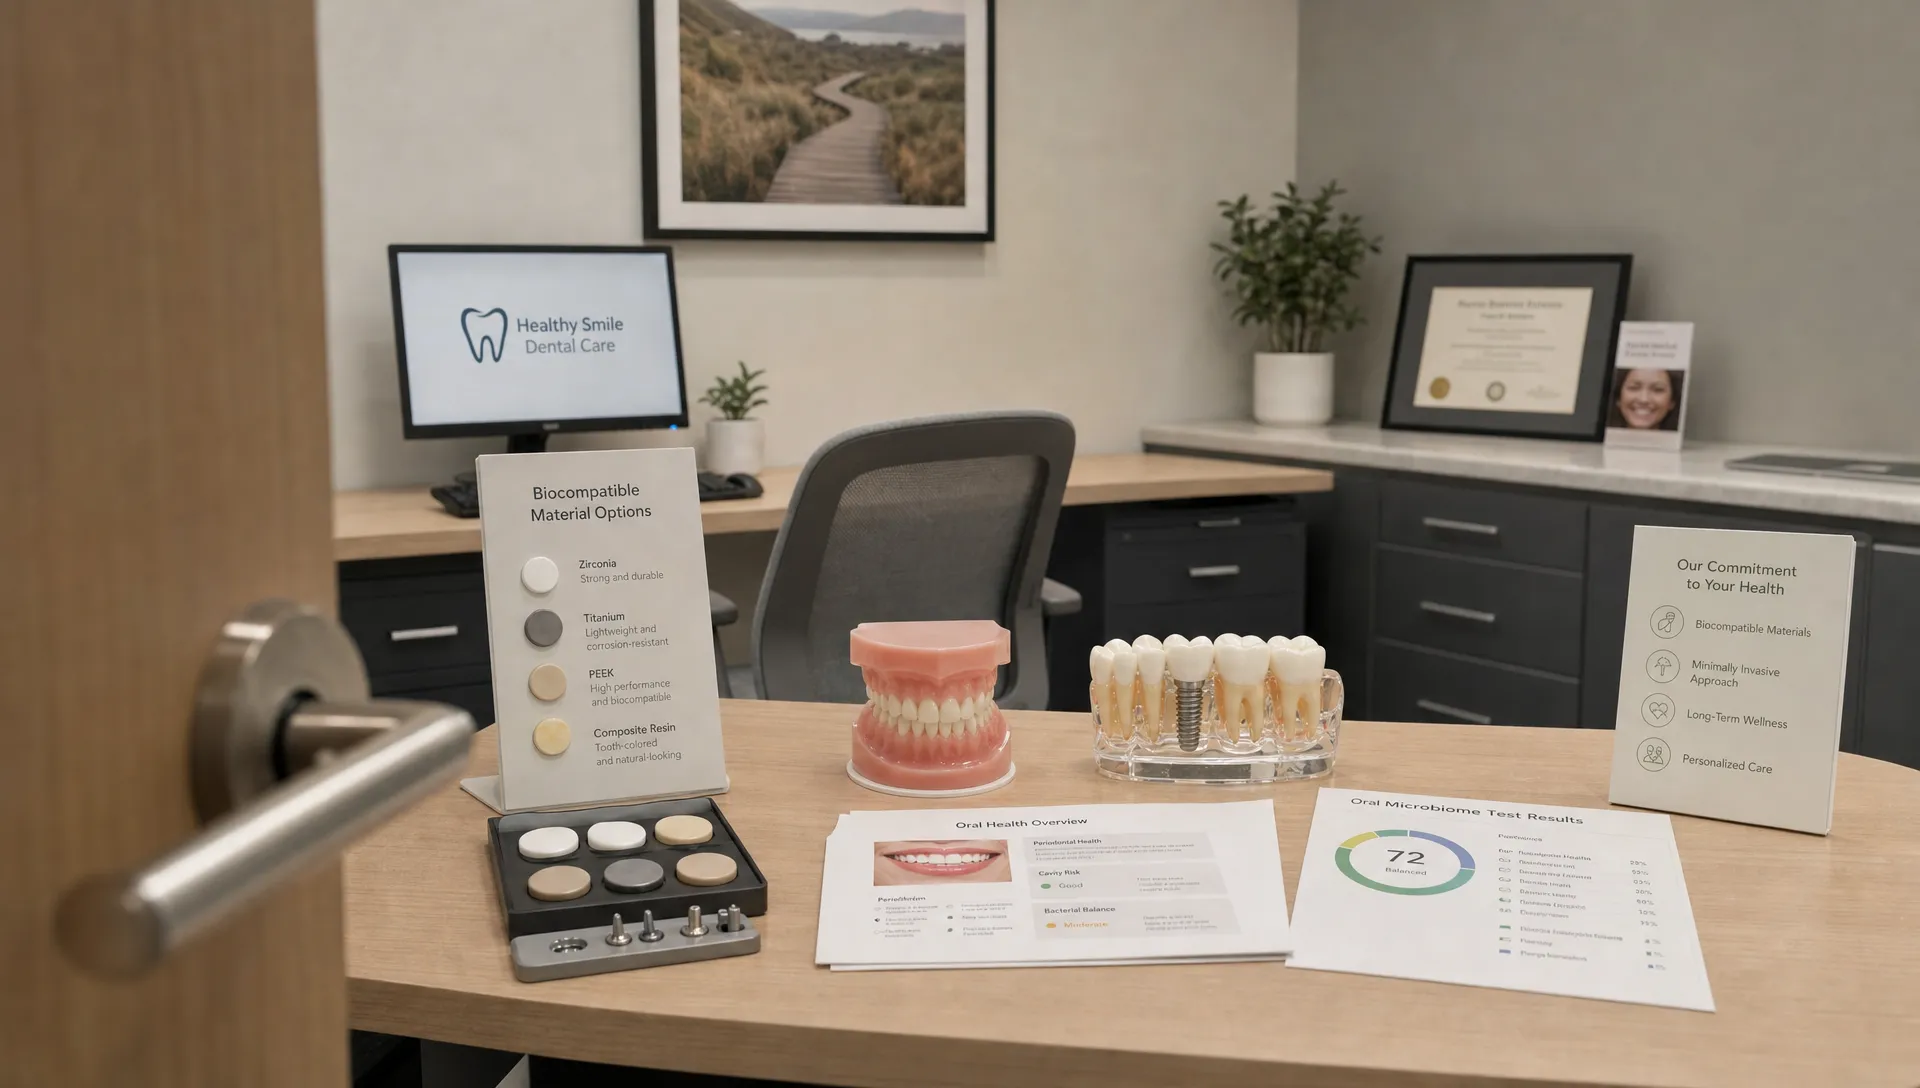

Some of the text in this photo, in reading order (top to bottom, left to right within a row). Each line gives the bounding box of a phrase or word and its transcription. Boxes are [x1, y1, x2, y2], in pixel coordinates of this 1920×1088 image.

[516, 316, 624, 336] Healthy Smile
[525, 338, 616, 354] Dental Care
[532, 483, 640, 501] Biocompatible
[530, 505, 652, 522] Material Options
[578, 559, 617, 569] Zirconia
[1677, 558, 1798, 578] Our Commitment
[580, 571, 664, 585] Strong and durable
[1686, 578, 1785, 596] to Your Health
[583, 612, 625, 623] Titanium
[585, 624, 657, 639] Lightweight and
[1695, 619, 1812, 638] Biocompatible Materials
[586, 638, 669, 651] corrosion-resistant
[588, 668, 614, 679] PEEK
[1691, 659, 1781, 678] Minimally Invasive
[590, 680, 671, 695] High performance
[1689, 674, 1739, 688] Approach
[591, 693, 672, 707] and biocompatible
[1686, 708, 1788, 730] Long-Term Wellness
[593, 723, 676, 739] Composite Resin
[594, 738, 658, 752] Tooth-colored
[596, 751, 682, 766] and natural-looking
[1682, 753, 1773, 774] Personalized Care
[1350, 797, 1584, 825] Oral Microbiome Test Results
[955, 817, 1088, 829] Oral Health Overview
[1386, 849, 1425, 866] 72
[1385, 866, 1427, 876] Balanced
